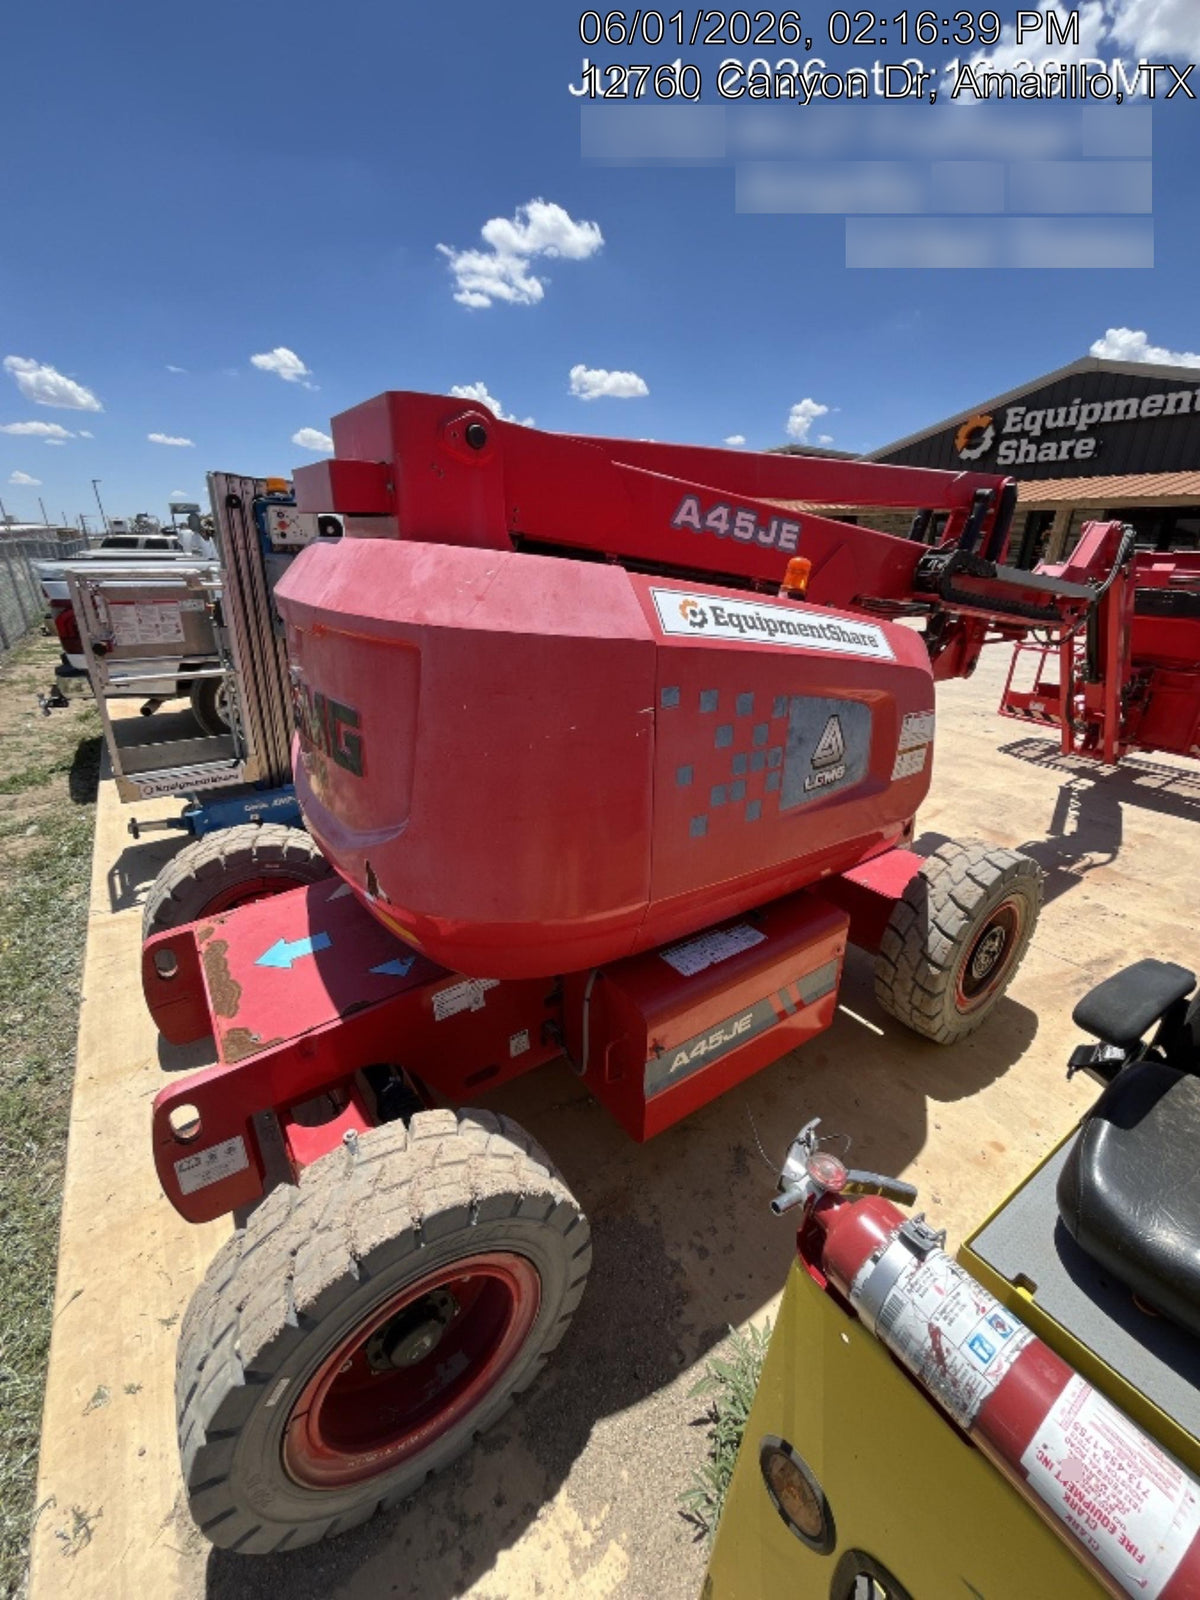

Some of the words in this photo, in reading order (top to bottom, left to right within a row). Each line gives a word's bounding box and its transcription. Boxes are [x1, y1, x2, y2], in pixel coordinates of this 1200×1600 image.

[997, 436, 1096, 465] Share
[672, 496, 801, 552] A45JE
[709, 605, 878, 649] EquipmentShare
[669, 1013, 753, 1074] A45JE
[1060, 1491, 1099, 1531] CLARK
[1115, 1532, 1147, 1564] FIRE
